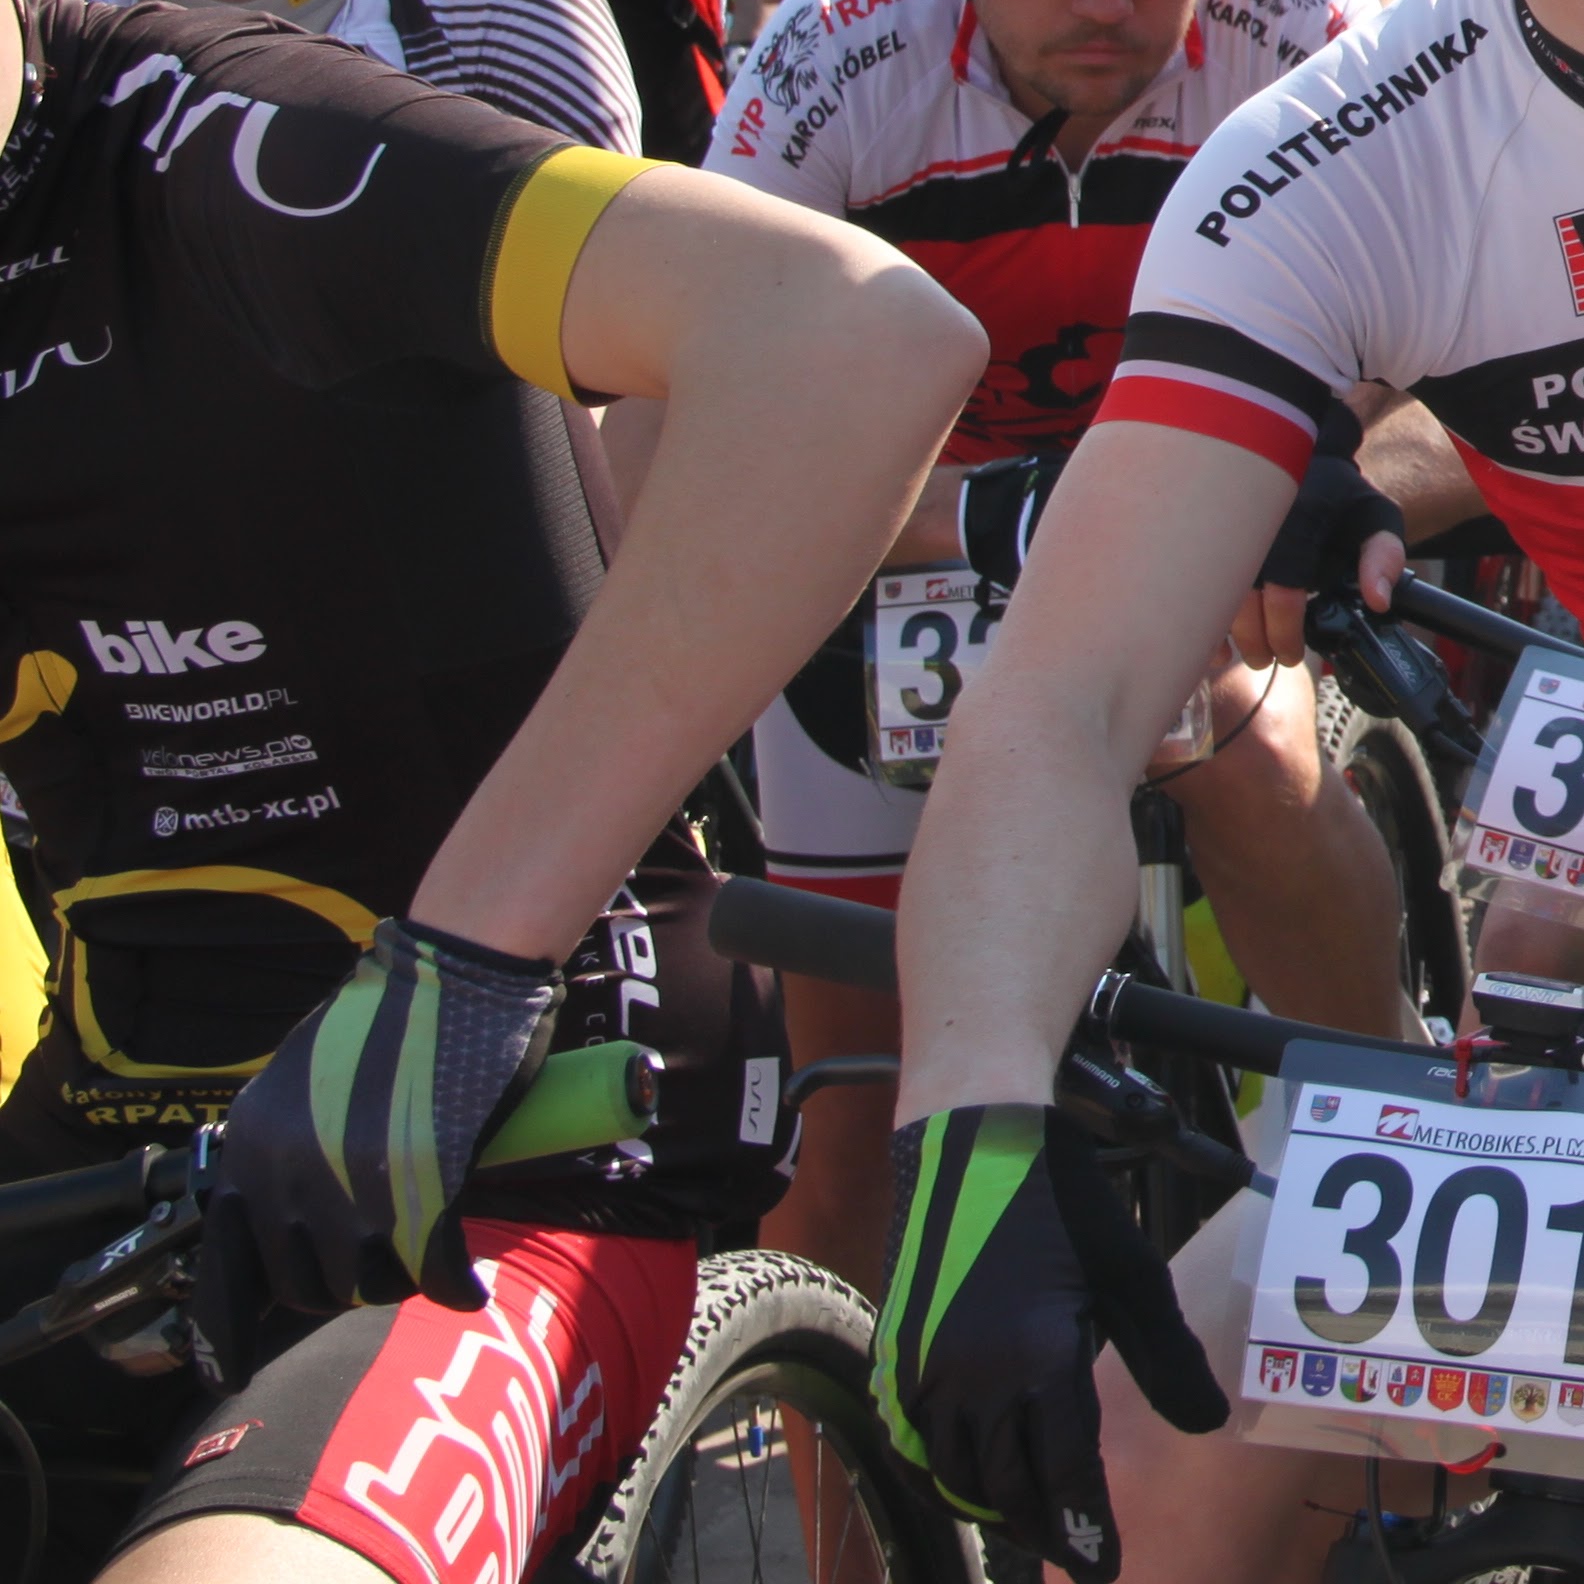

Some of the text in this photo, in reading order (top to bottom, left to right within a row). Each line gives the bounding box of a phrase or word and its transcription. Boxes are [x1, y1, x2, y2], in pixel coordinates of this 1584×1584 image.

[1194, 17, 1488, 247] POLITECHNIKA
[79, 619, 267, 674] bike
[184, 786, 341, 831] mtb-xc.pl
[1488, 982, 1565, 1004] GIANT
[1413, 1124, 1567, 1157] METROBIKES.PL
[93, 1285, 140, 1312] SHIMANO
